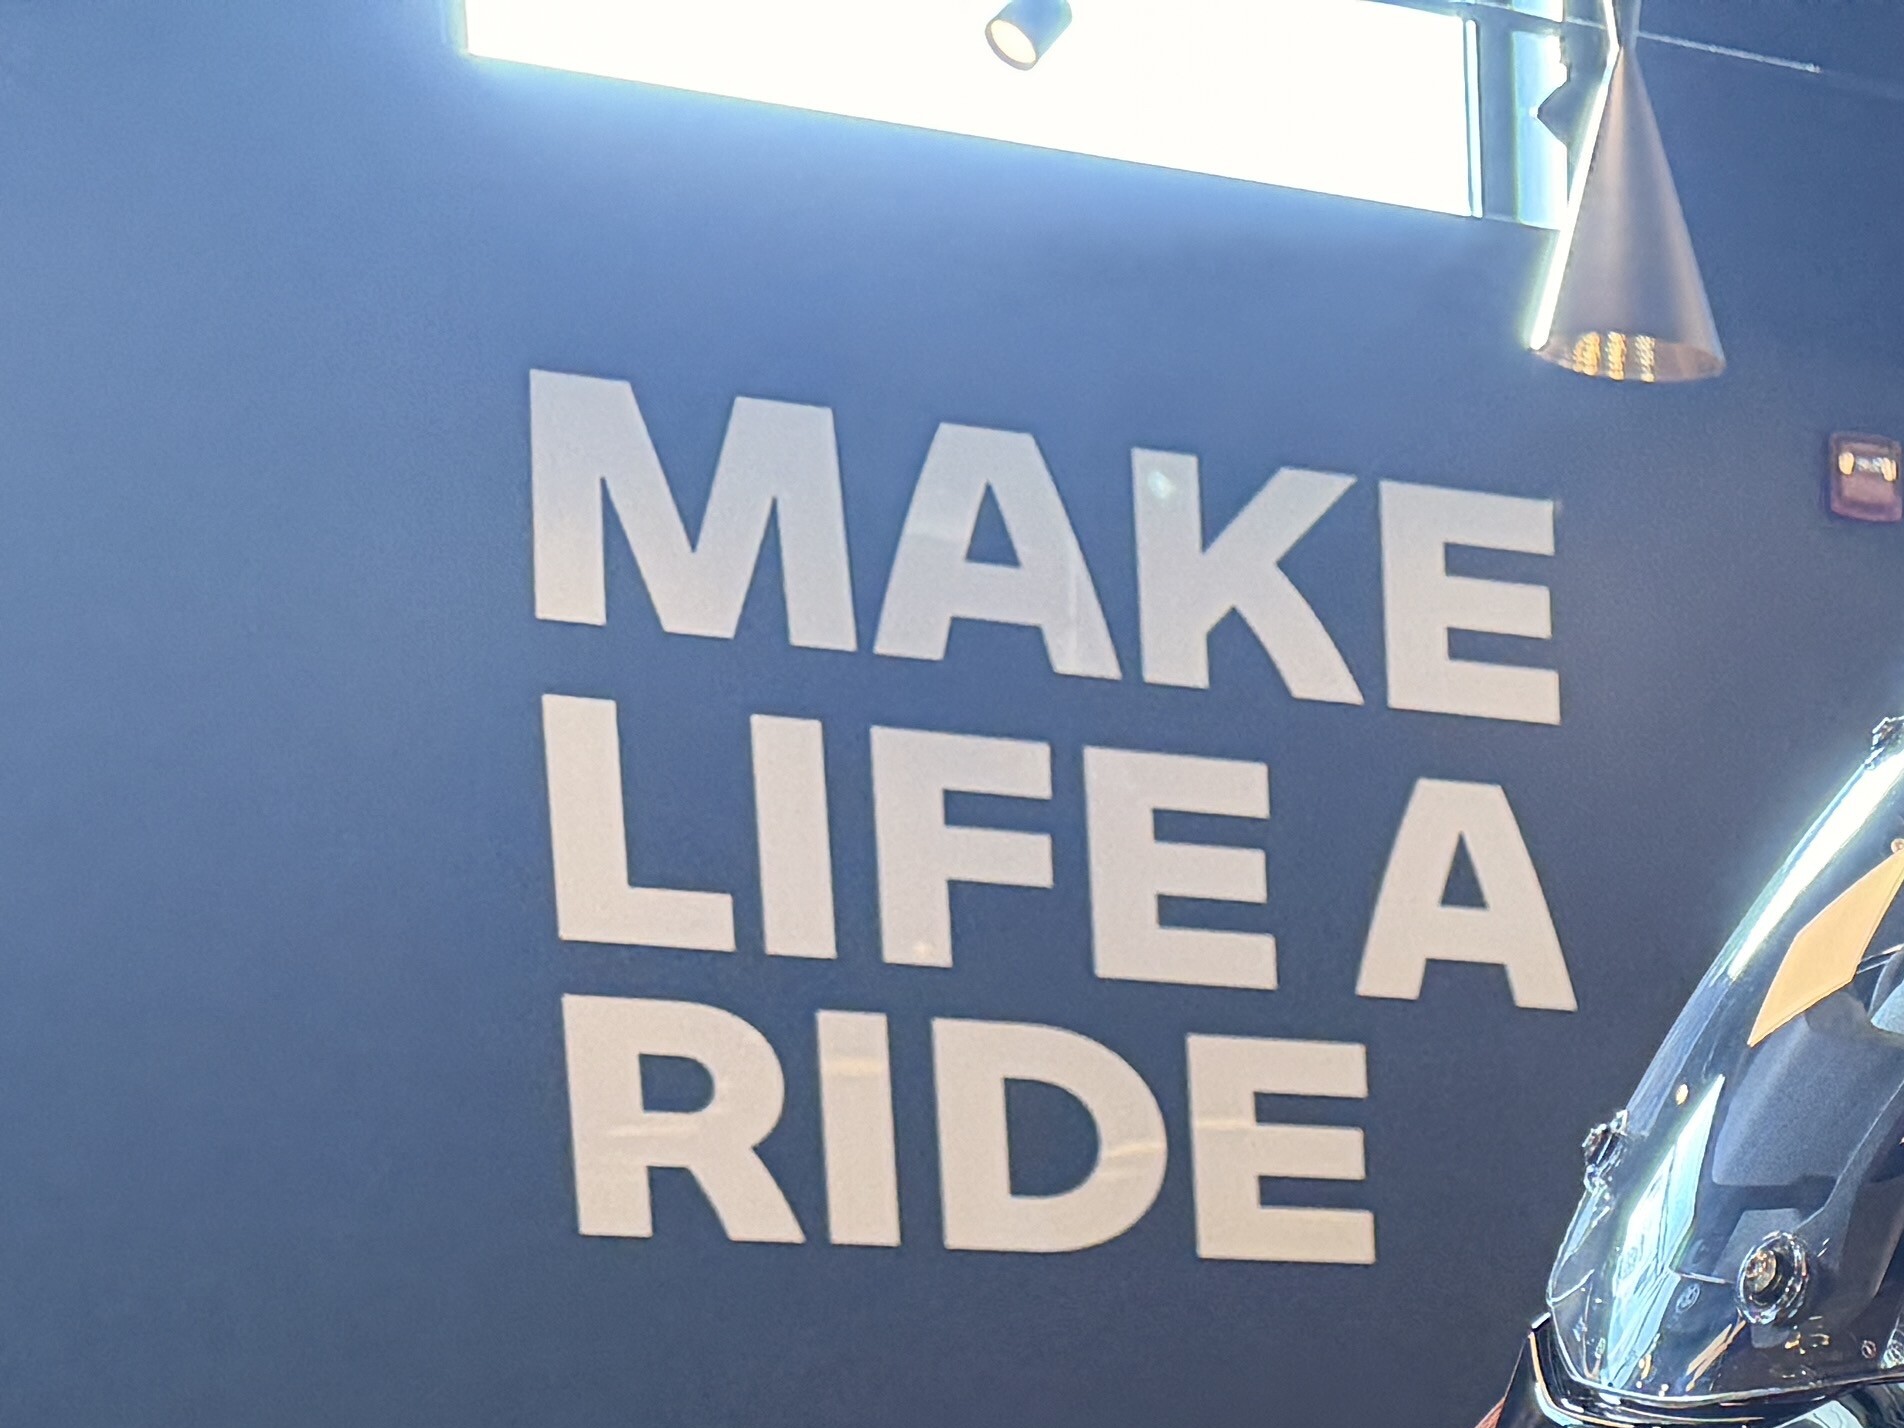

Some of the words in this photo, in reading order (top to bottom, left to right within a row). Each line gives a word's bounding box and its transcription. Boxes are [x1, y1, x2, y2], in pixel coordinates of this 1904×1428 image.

[529, 367, 1562, 727] MAKE
[540, 691, 1279, 991] LIFE
[1353, 778, 1577, 1013] A
[561, 993, 1377, 1266] RIDE
